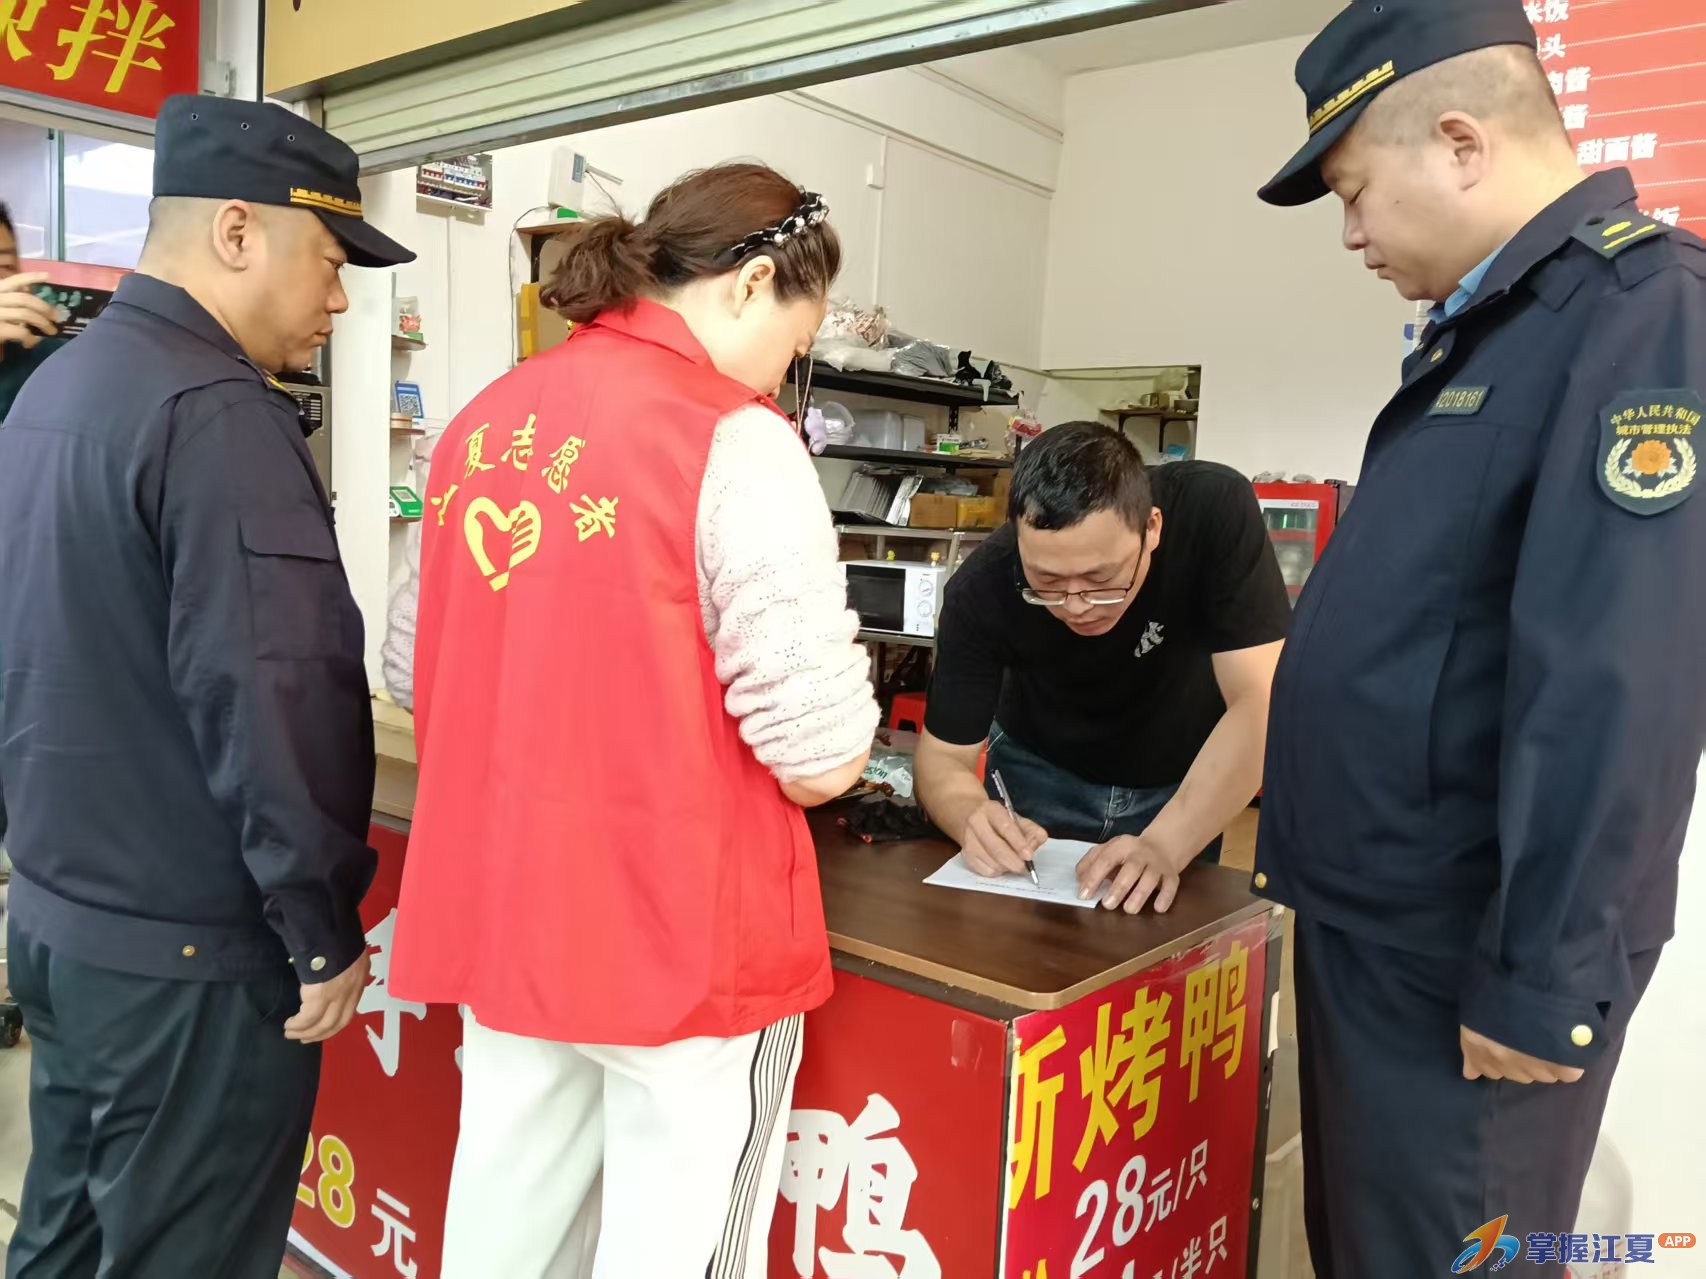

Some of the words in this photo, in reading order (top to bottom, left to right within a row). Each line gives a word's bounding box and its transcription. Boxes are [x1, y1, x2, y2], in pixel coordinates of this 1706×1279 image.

[1536, 33, 1567, 60] 头
[1610, 404, 1702, 426] 中华人民共和国
[1616, 423, 1693, 436] 城市管理执法
